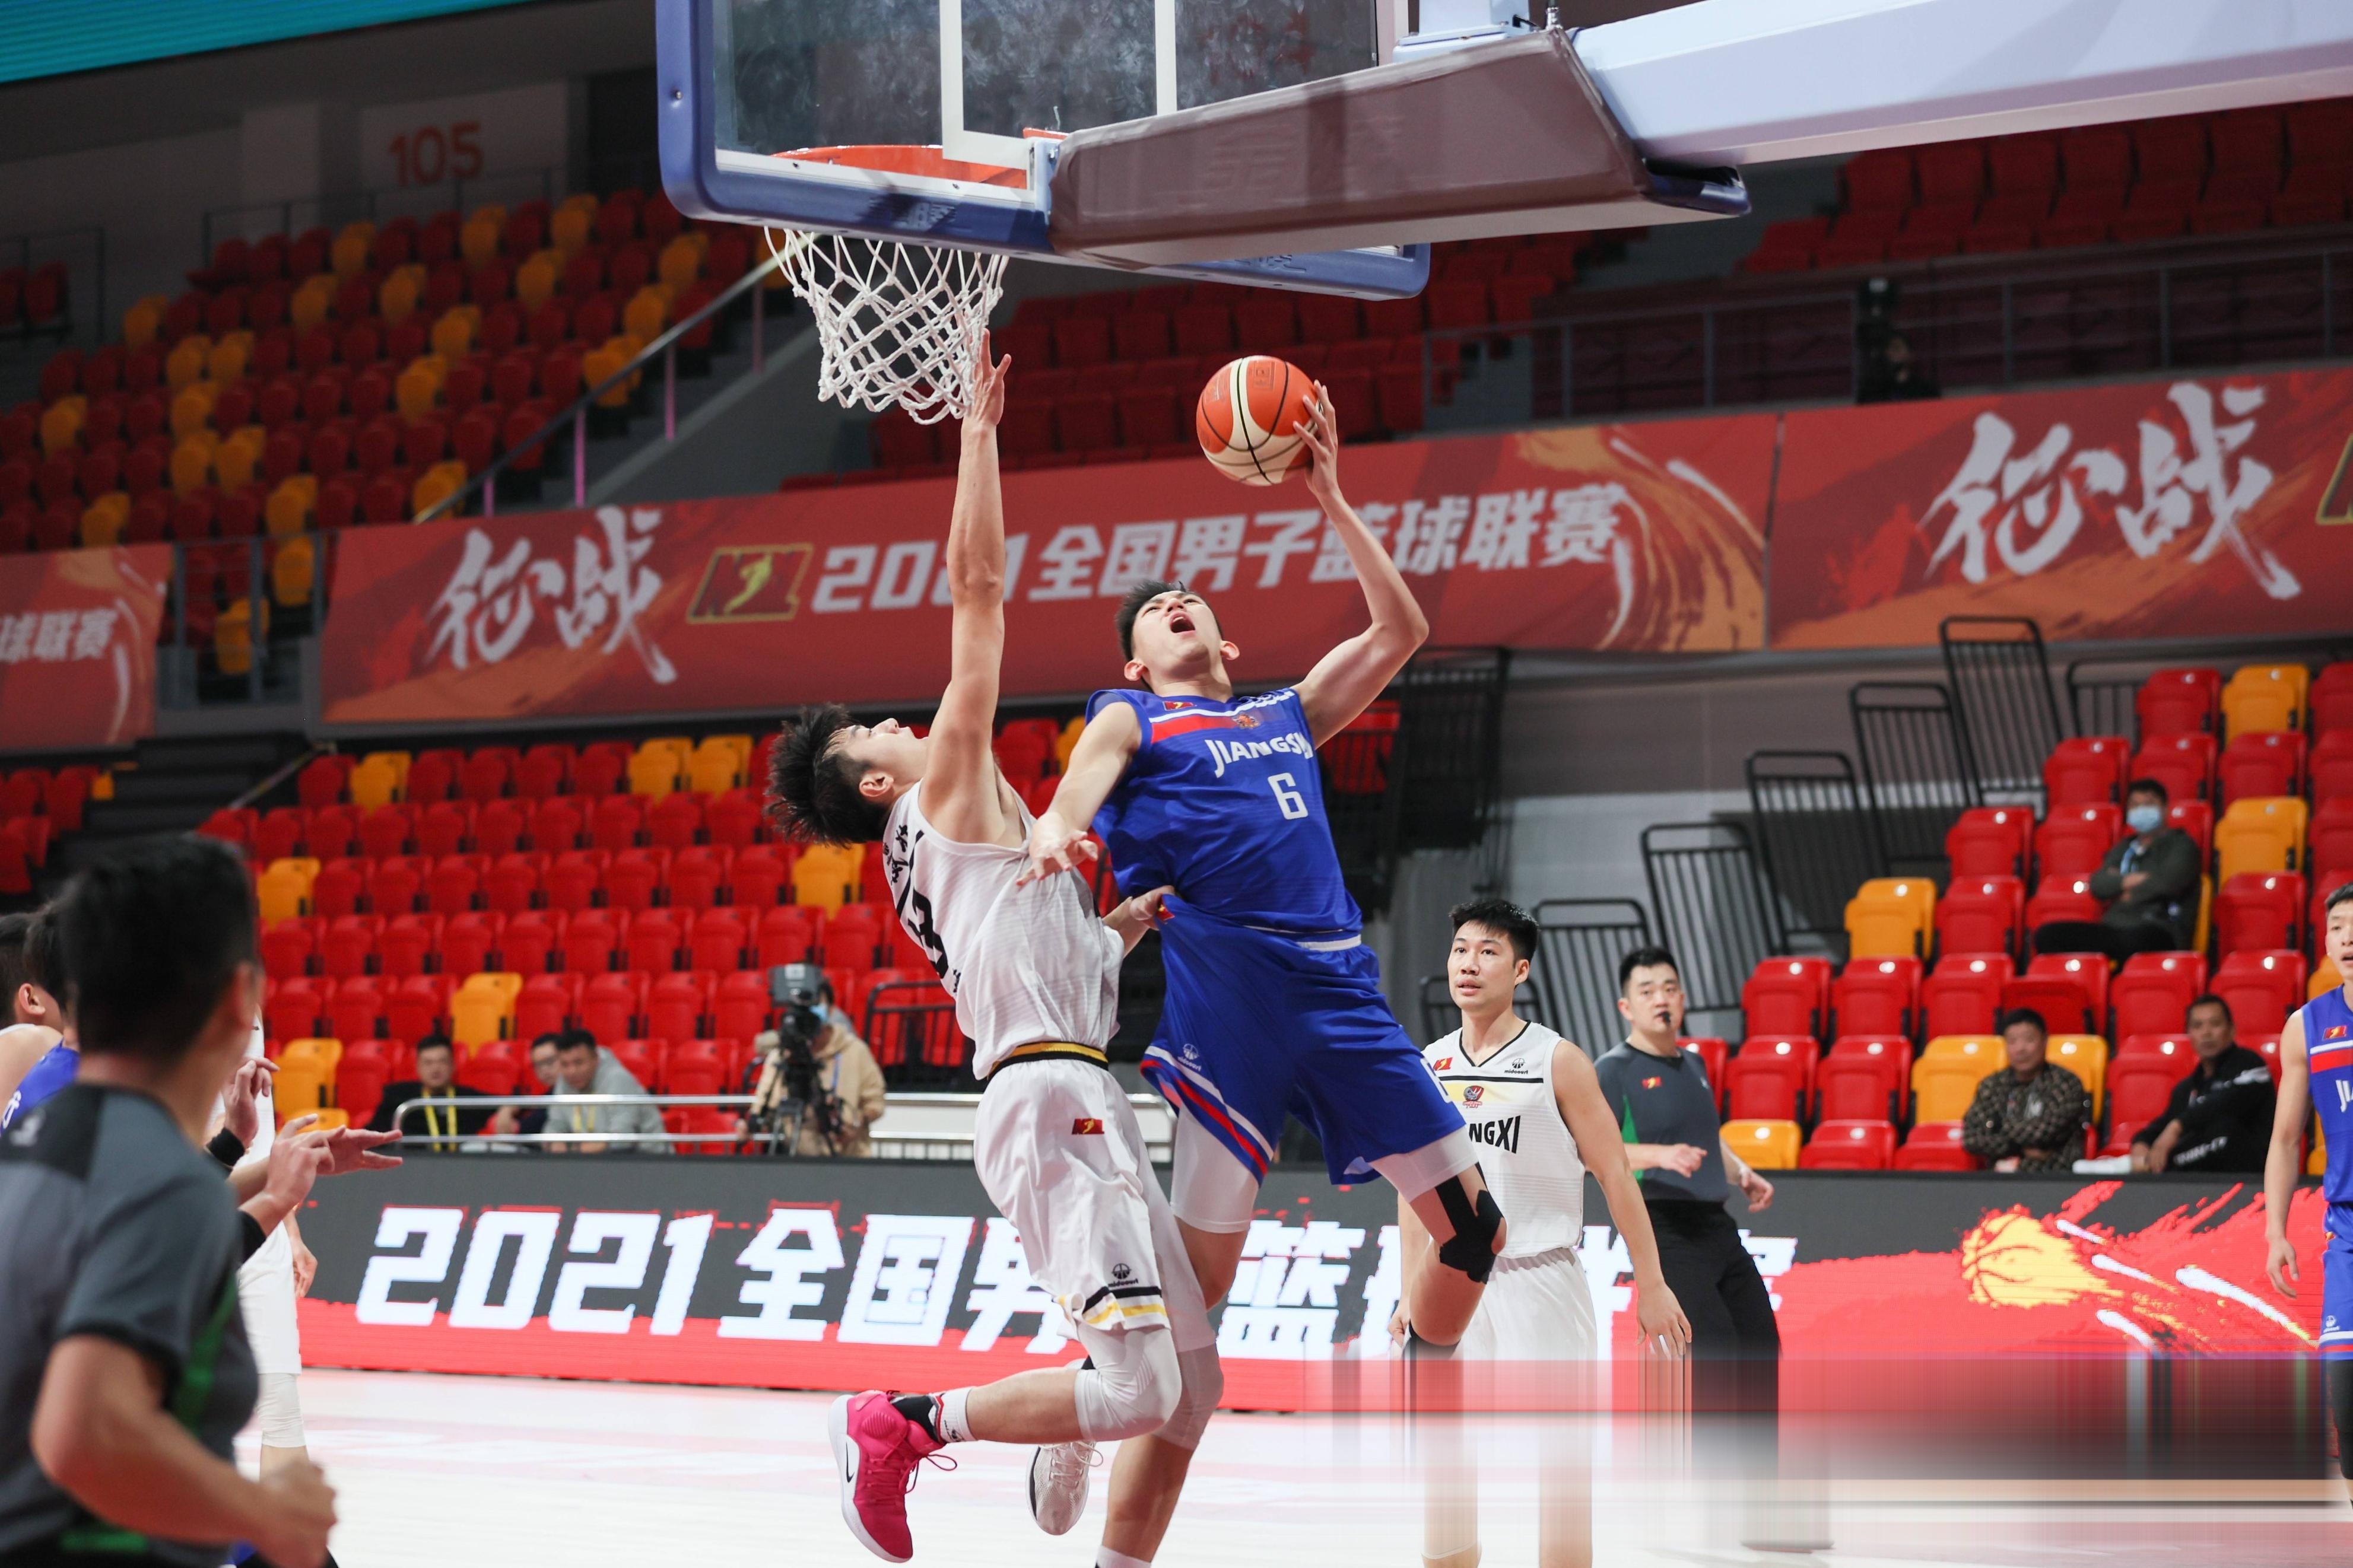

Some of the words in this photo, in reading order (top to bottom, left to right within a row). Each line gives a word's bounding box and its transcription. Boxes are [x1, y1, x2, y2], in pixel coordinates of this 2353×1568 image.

[390, 122, 484, 187] 105
[811, 482, 1627, 613] 201全国男子篮球联赛
[1268, 772, 1308, 820] 6
[1469, 1115, 1521, 1154] NGXI
